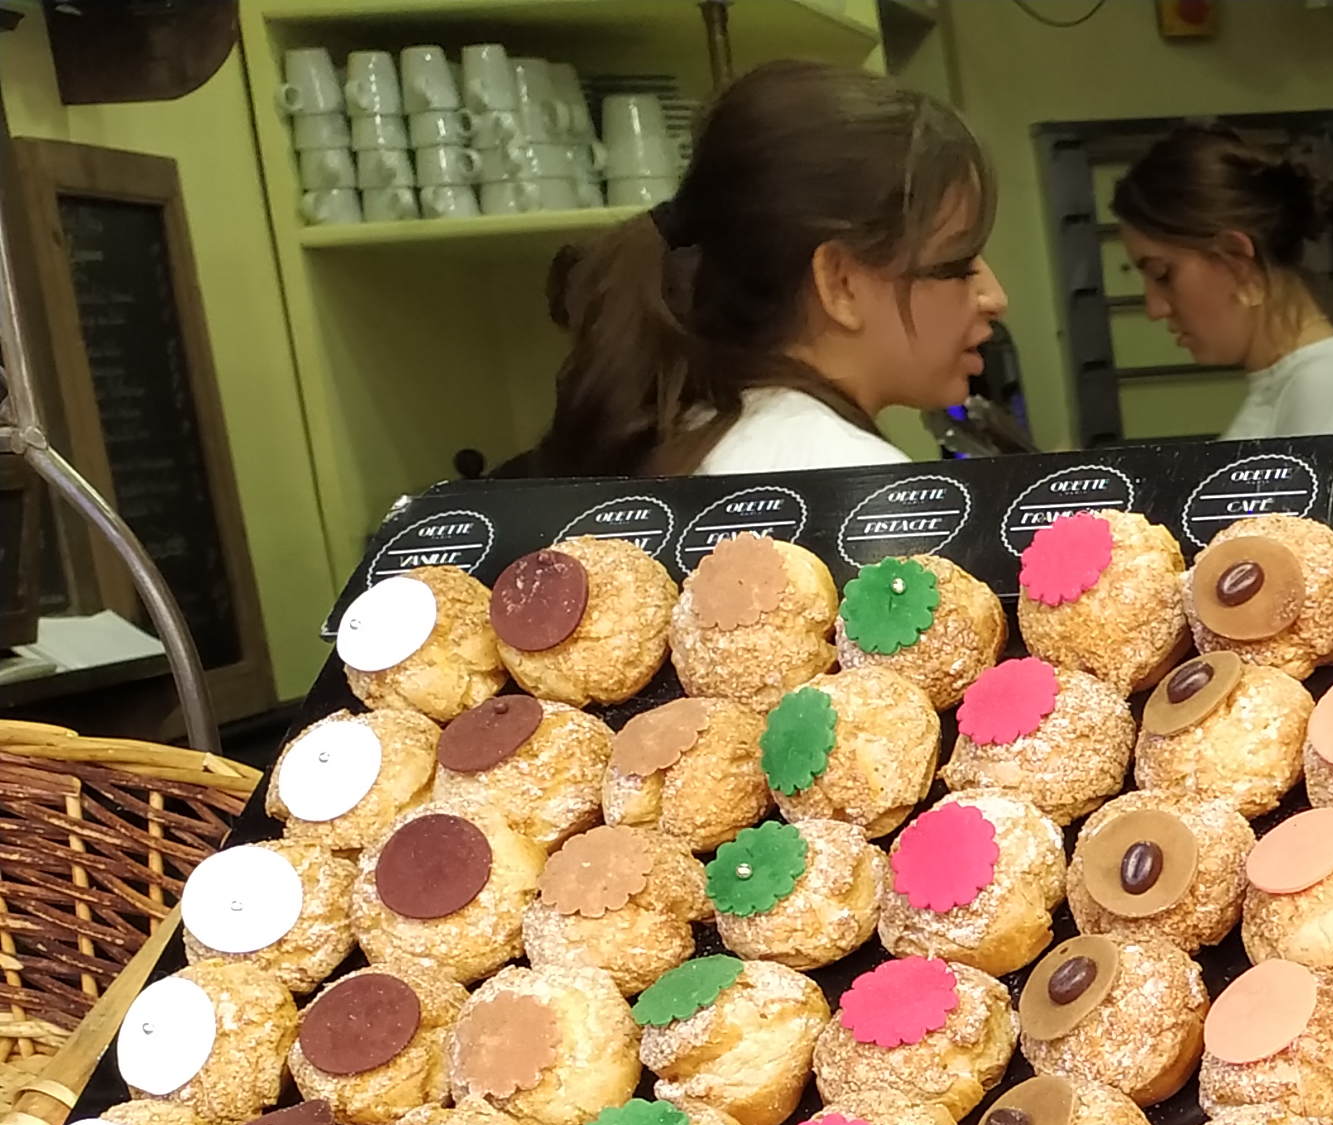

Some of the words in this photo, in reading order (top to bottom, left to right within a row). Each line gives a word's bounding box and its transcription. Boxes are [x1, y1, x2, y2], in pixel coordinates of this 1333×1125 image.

[1231, 468, 1292, 481] ODETTE
[1050, 479, 1110, 492] ODETTE
[888, 488, 947, 502] ODETTE
[726, 499, 784, 513] ODETTE
[1227, 497, 1275, 512] CAFÉ
[596, 509, 652, 522] ODETTE
[418, 523, 474, 537] ODETTE
[864, 518, 942, 534] PISTACHE
[399, 552, 462, 567] VANILLE
